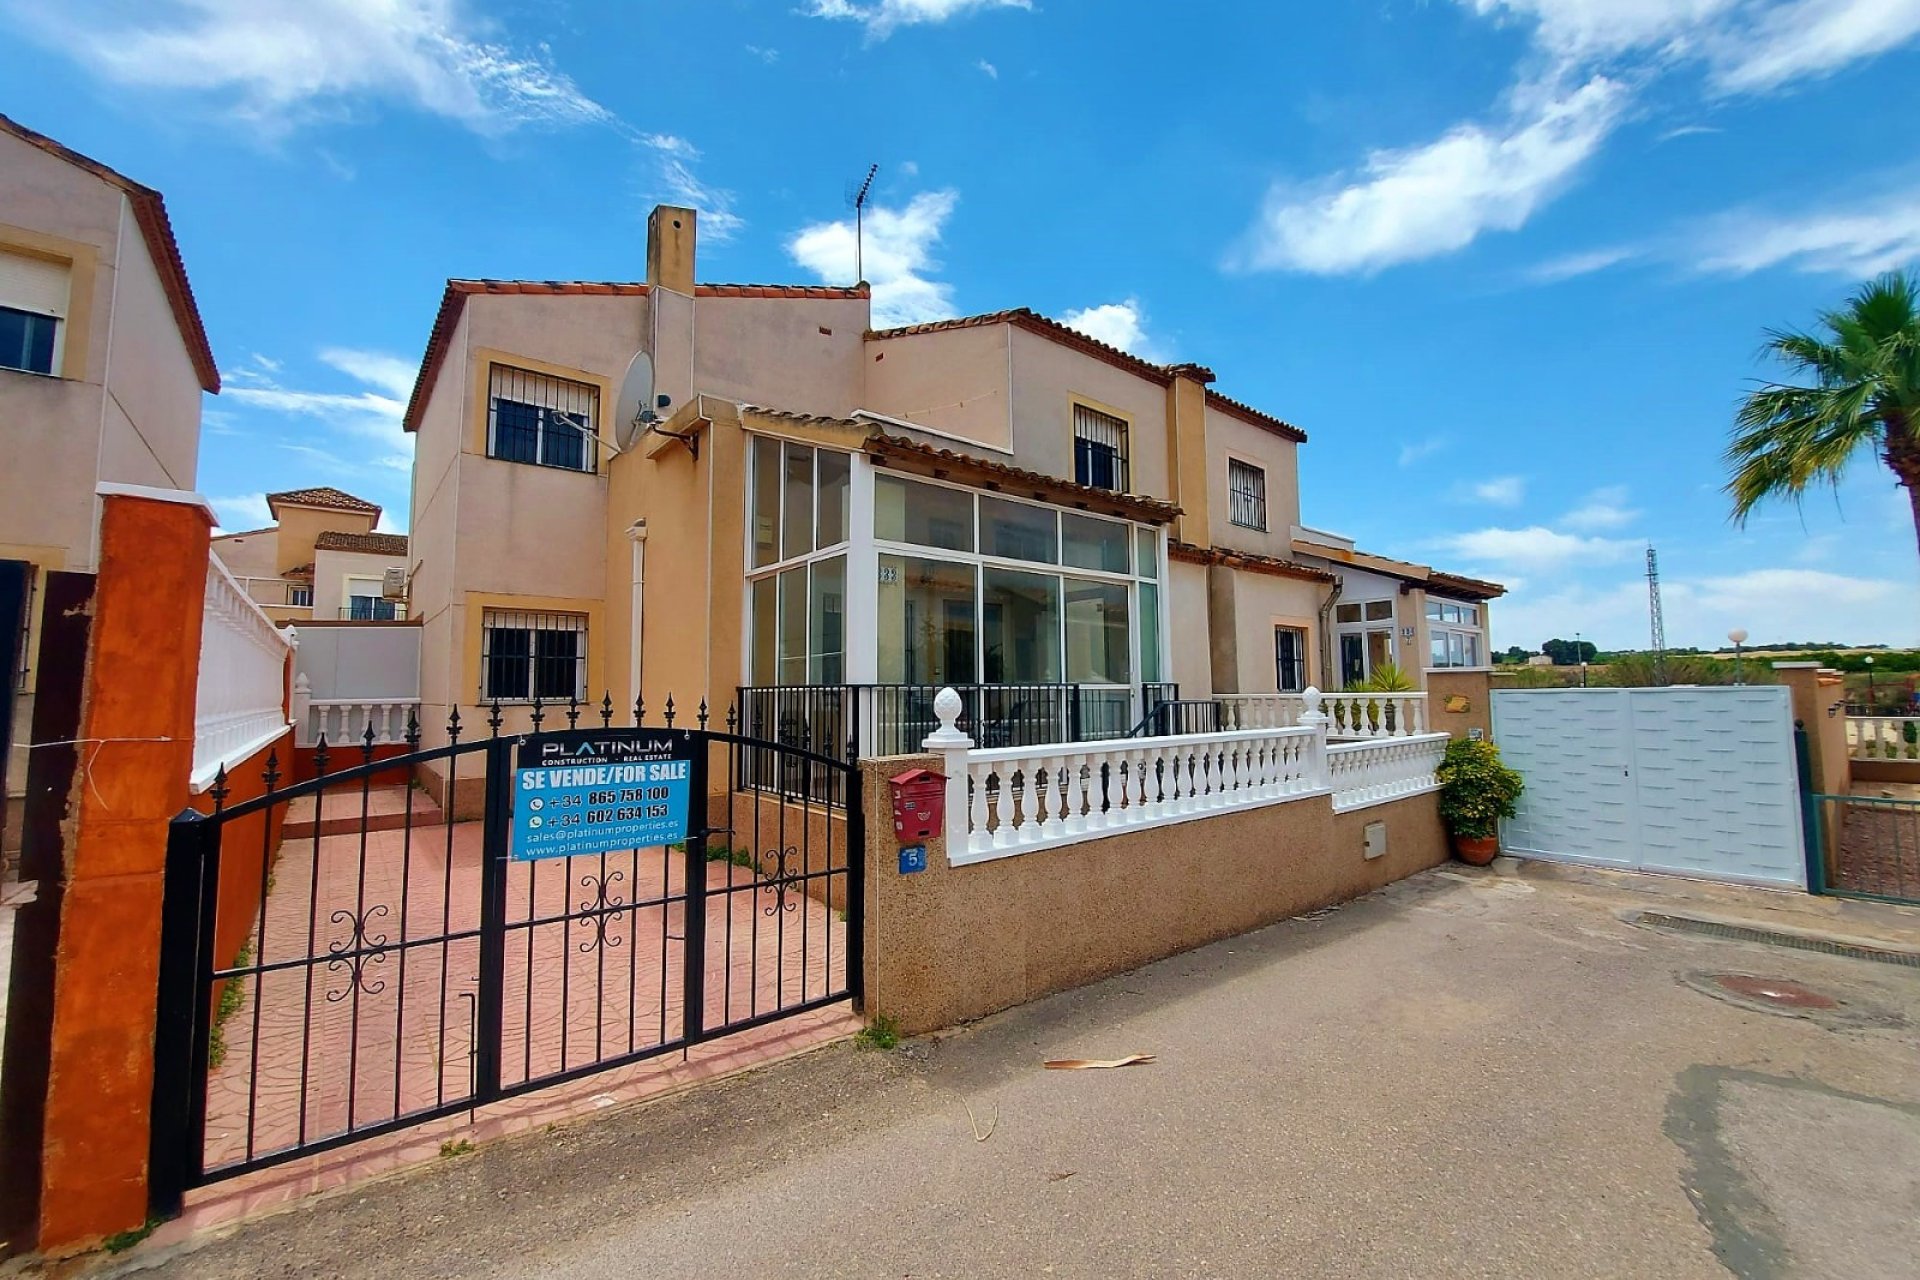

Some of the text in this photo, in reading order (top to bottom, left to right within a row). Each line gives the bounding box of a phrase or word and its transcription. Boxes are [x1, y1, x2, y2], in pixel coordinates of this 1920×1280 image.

[541, 753, 672, 767] CONSTRUCTION REAL ESTATE
[542, 739, 673, 757] PLATINUM
[522, 762, 686, 790] SE VENDE/FOR SALE
[549, 786, 669, 810] +34 865 758 100
[547, 804, 668, 828] +34 602 634 153
[526, 819, 679, 844] sales@platinumproperties.es
[526, 831, 678, 857] www.platinumproperties.es
[909, 853, 918, 867] 5
